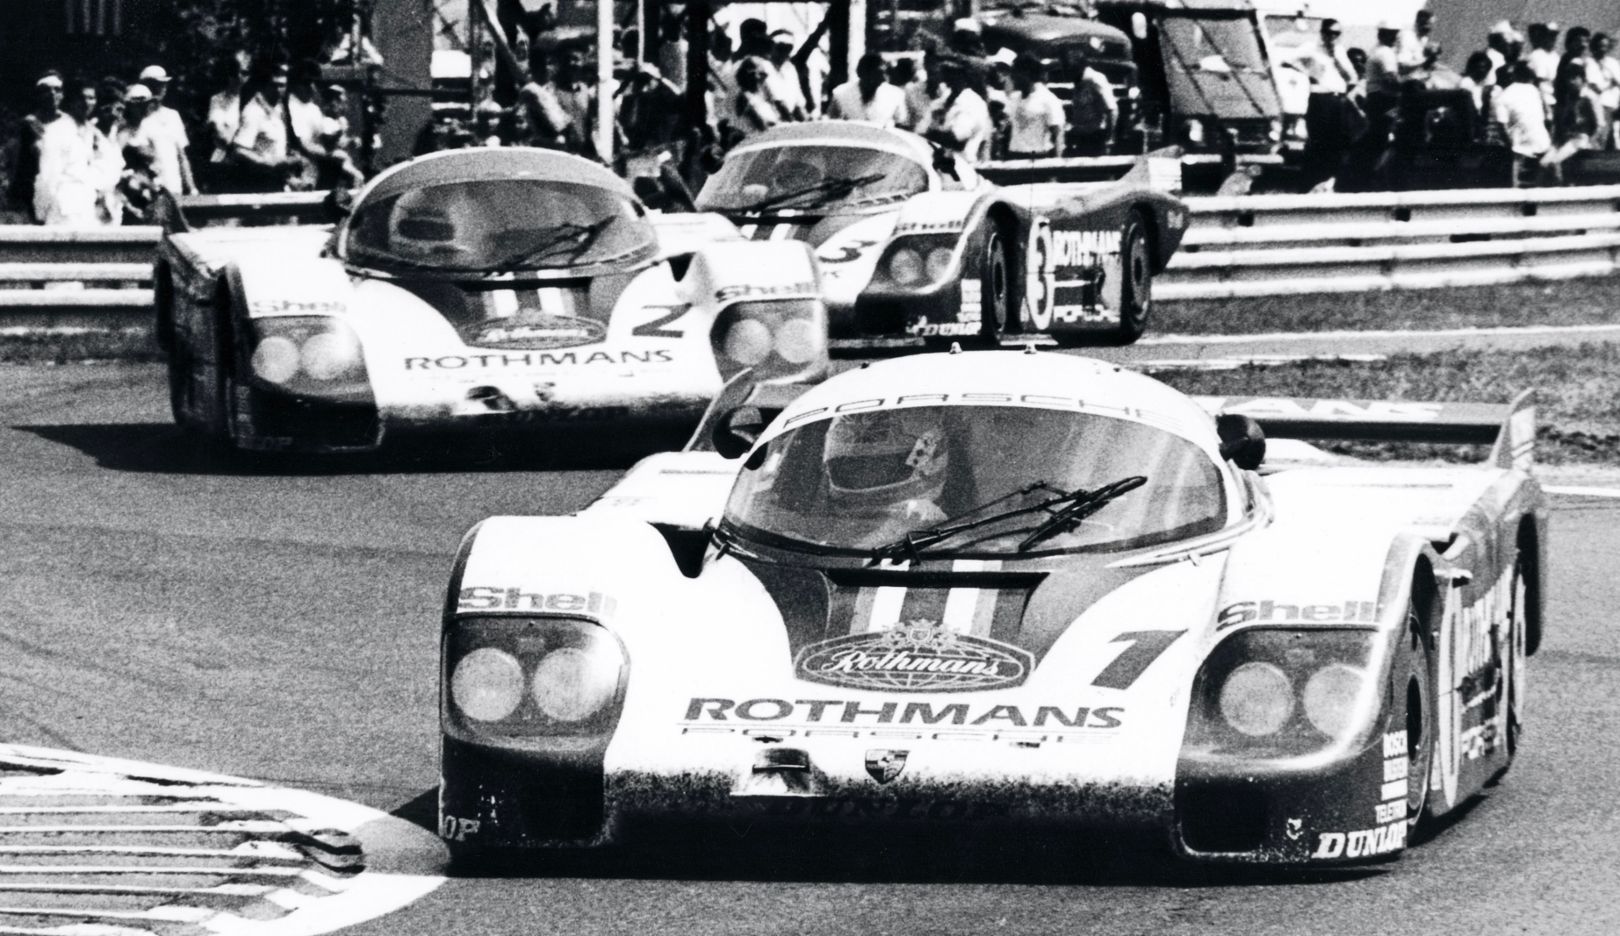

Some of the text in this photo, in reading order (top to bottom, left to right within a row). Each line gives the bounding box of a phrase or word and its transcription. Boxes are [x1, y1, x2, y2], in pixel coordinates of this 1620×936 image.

[633, 302, 693, 338] 2
[404, 350, 675, 371] ROTHMANS
[782, 392, 1184, 432] PORSCHE
[458, 586, 617, 613] Shell
[1216, 600, 1379, 632] Shell
[821, 651, 1000, 676] Rothmans
[1089, 627, 1190, 691] 1
[684, 697, 1126, 729] ROTHMANS
[681, 726, 1114, 745] PORSCHE
[1311, 818, 1407, 859] DUNLOP
